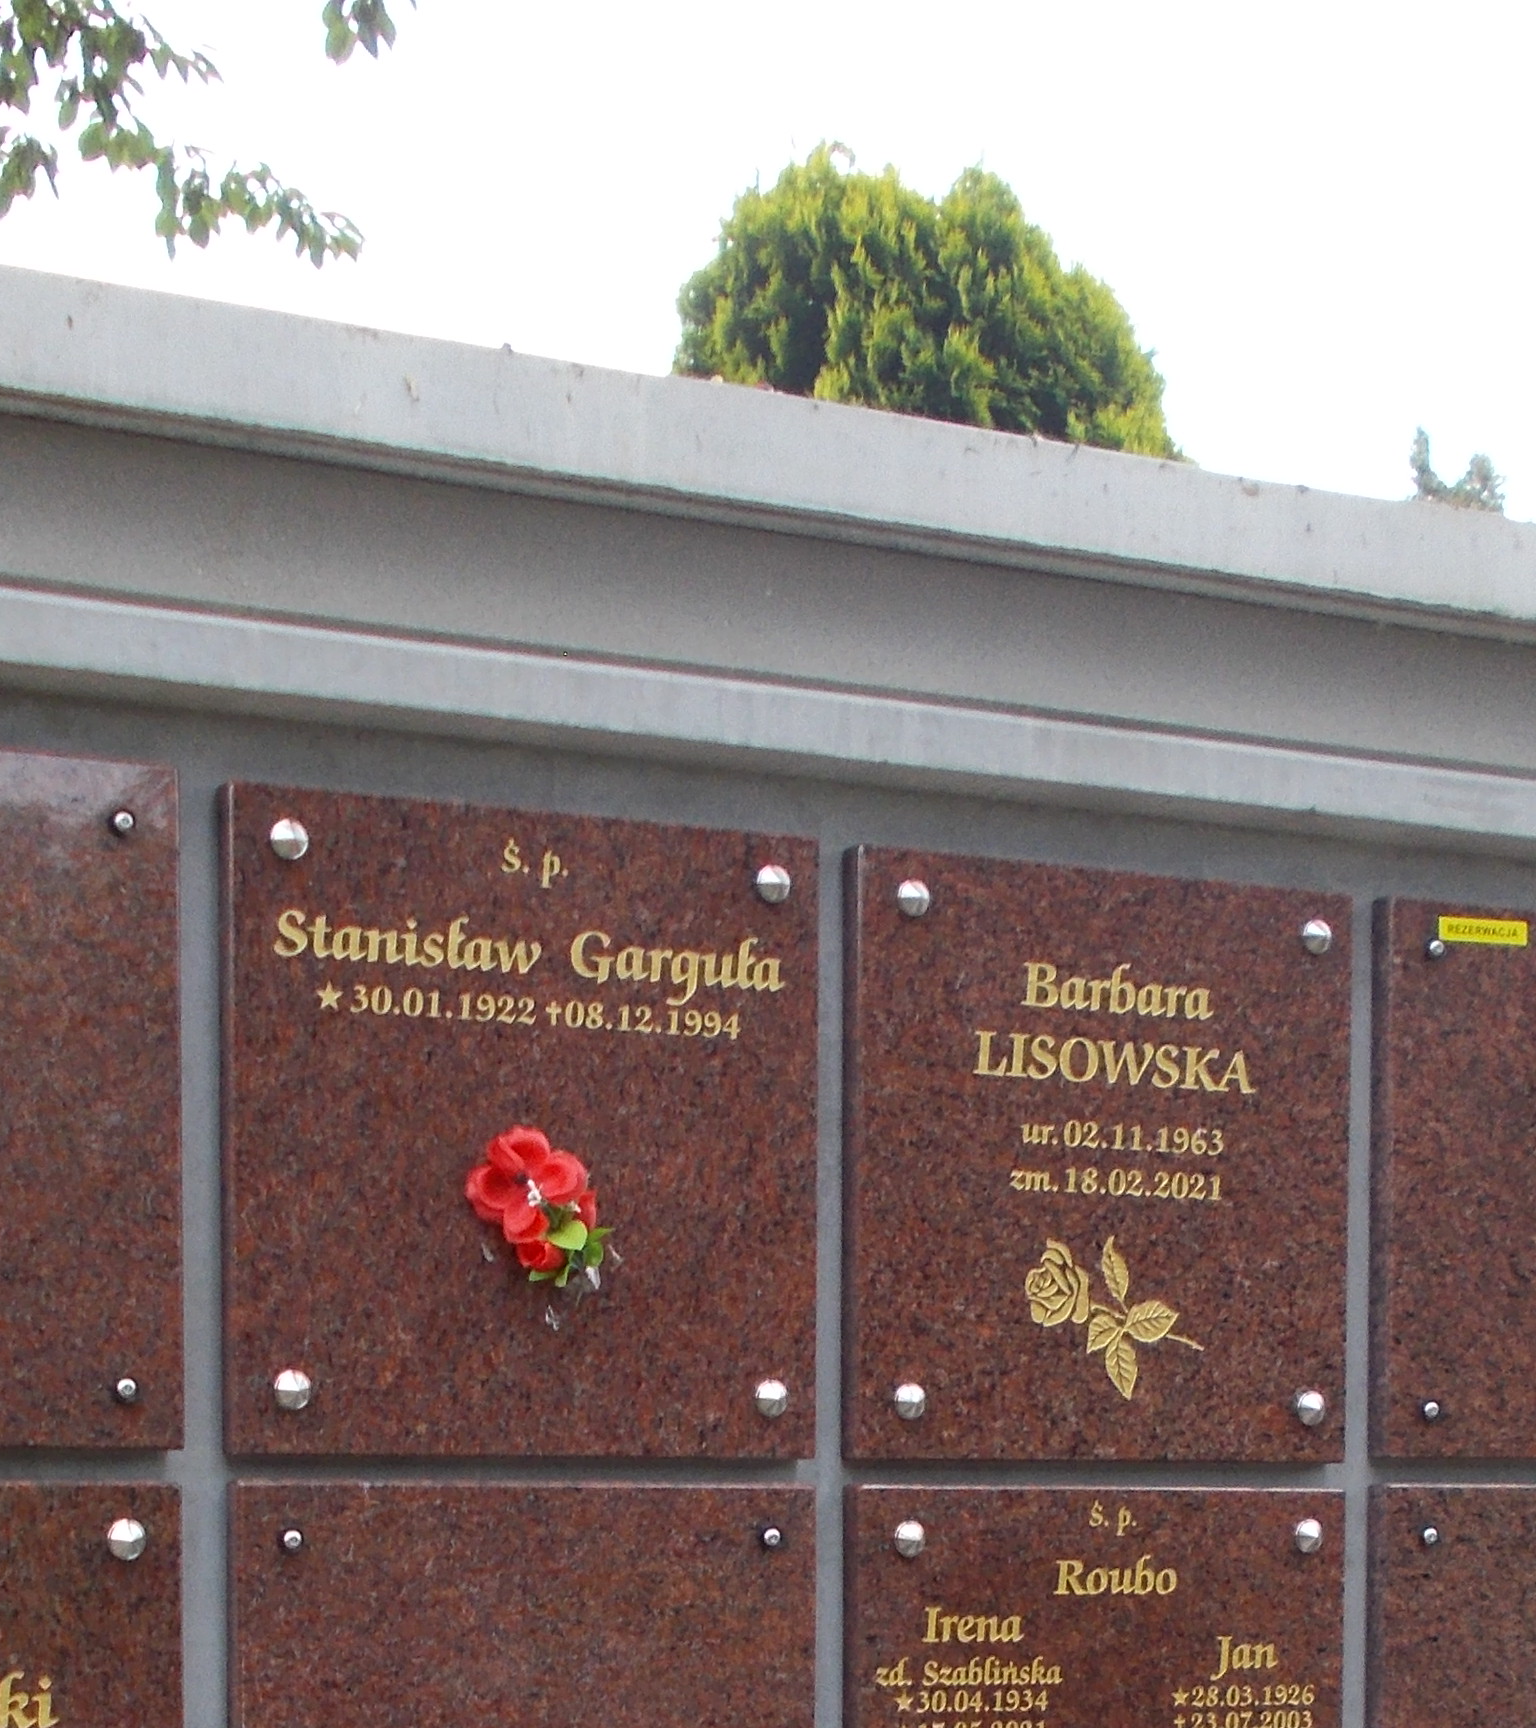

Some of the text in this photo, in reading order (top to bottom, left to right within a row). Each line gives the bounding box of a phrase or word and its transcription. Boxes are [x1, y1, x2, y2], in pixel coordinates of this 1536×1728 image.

[1447, 924, 1519, 938] REZERWACJA
[272, 909, 785, 1006] Stanisław Garguła
[1021, 962, 1214, 1020] Barbara
[973, 1030, 1256, 1095] LISOWSKA
[1054, 1554, 1177, 1596] Roubo
[922, 1606, 1024, 1644] Irena
[875, 1657, 1062, 1687] zd. Szablińska
[1211, 1636, 1277, 1680] Jan
